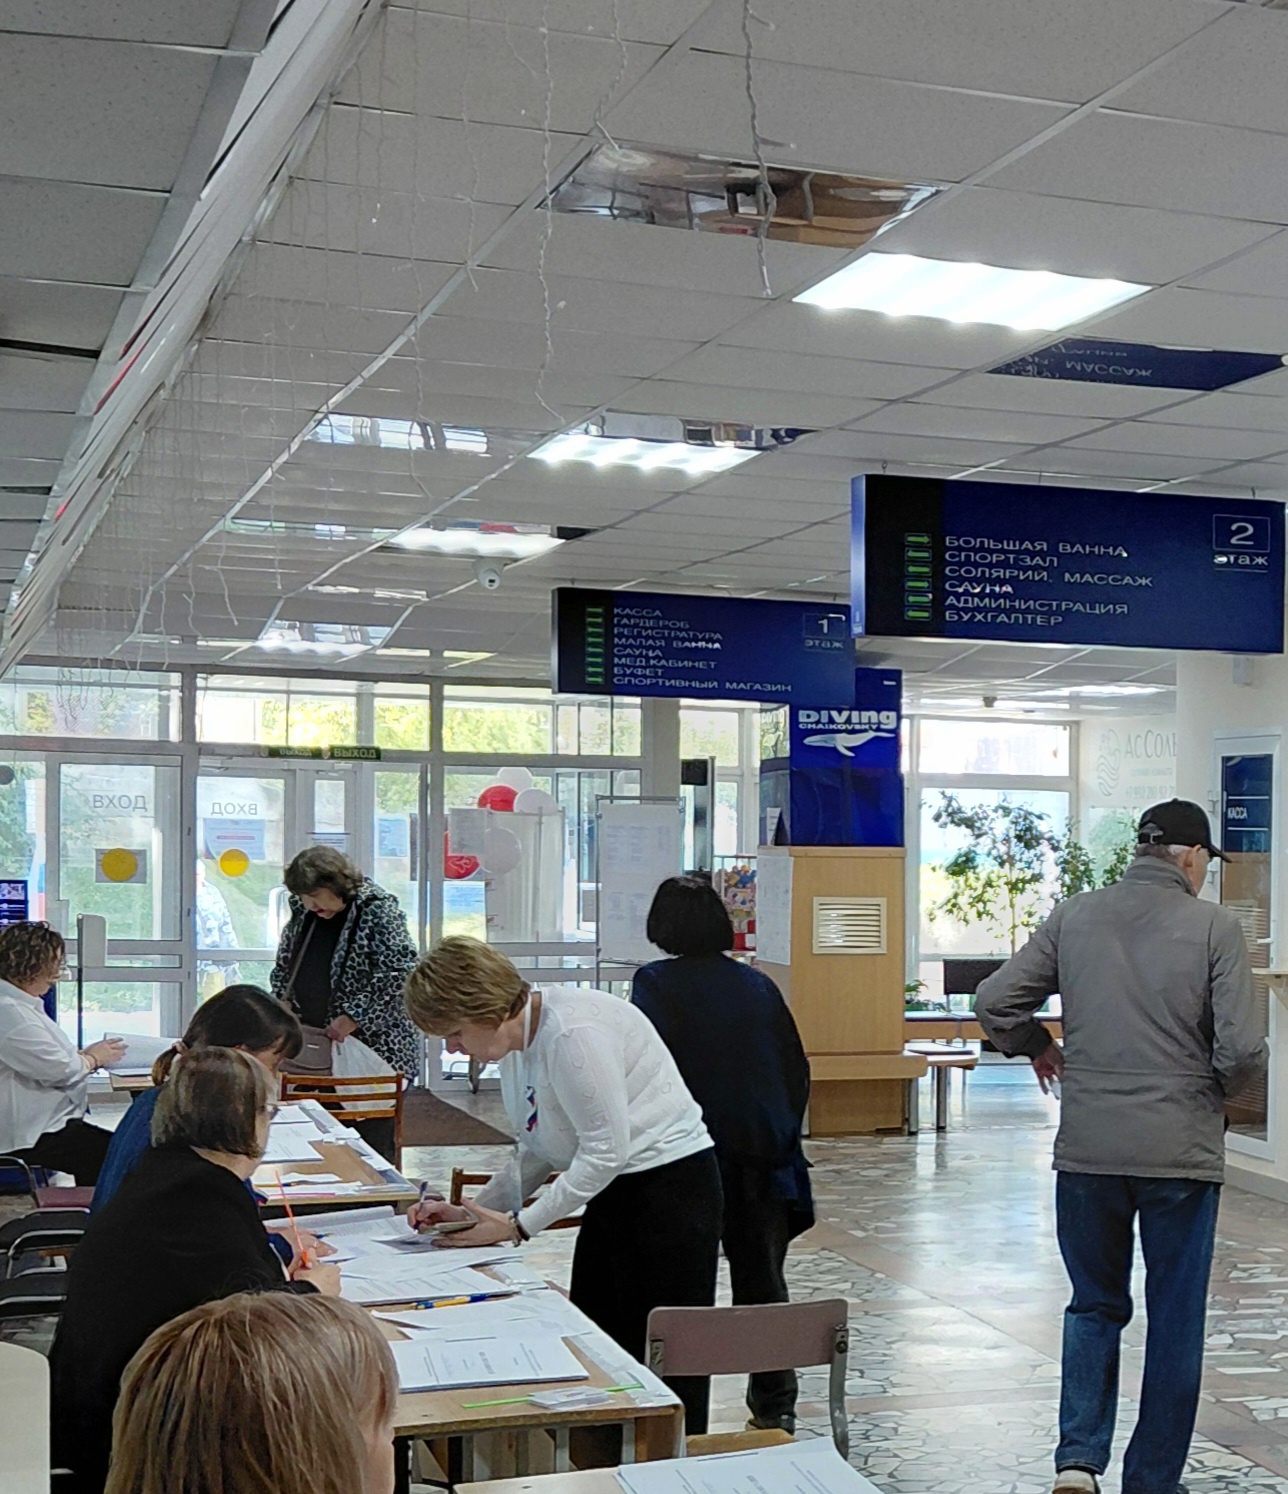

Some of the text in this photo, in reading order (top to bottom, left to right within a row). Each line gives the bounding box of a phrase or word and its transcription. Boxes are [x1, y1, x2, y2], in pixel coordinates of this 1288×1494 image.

[1229, 522, 1255, 545] 2
[945, 536, 1128, 557] БОЛЬШАЯ ВАННА
[944, 551, 1058, 567] СПОРТЗАЛ
[1213, 554, 1269, 566] этаж
[1063, 572, 1153, 587] МАССАЖ
[944, 581, 1014, 594] САУНА
[944, 595, 1128, 615] АДМИНИСТРАЦИЯ
[613, 608, 663, 617] КАССА
[945, 610, 1063, 626] БУХГАЛТЕР
[613, 617, 690, 629] ГАРДЕРОБ
[818, 618, 829, 634] 1
[613, 627, 723, 640] РЕГИСТРАТУРА
[613, 638, 722, 650] МАЛАЯ ВАННА
[613, 647, 663, 657] САУНА
[613, 667, 665, 676] БУФЕТ
[725, 682, 793, 692] МАГАЗИН
[93, 795, 148, 812] ВХОД
